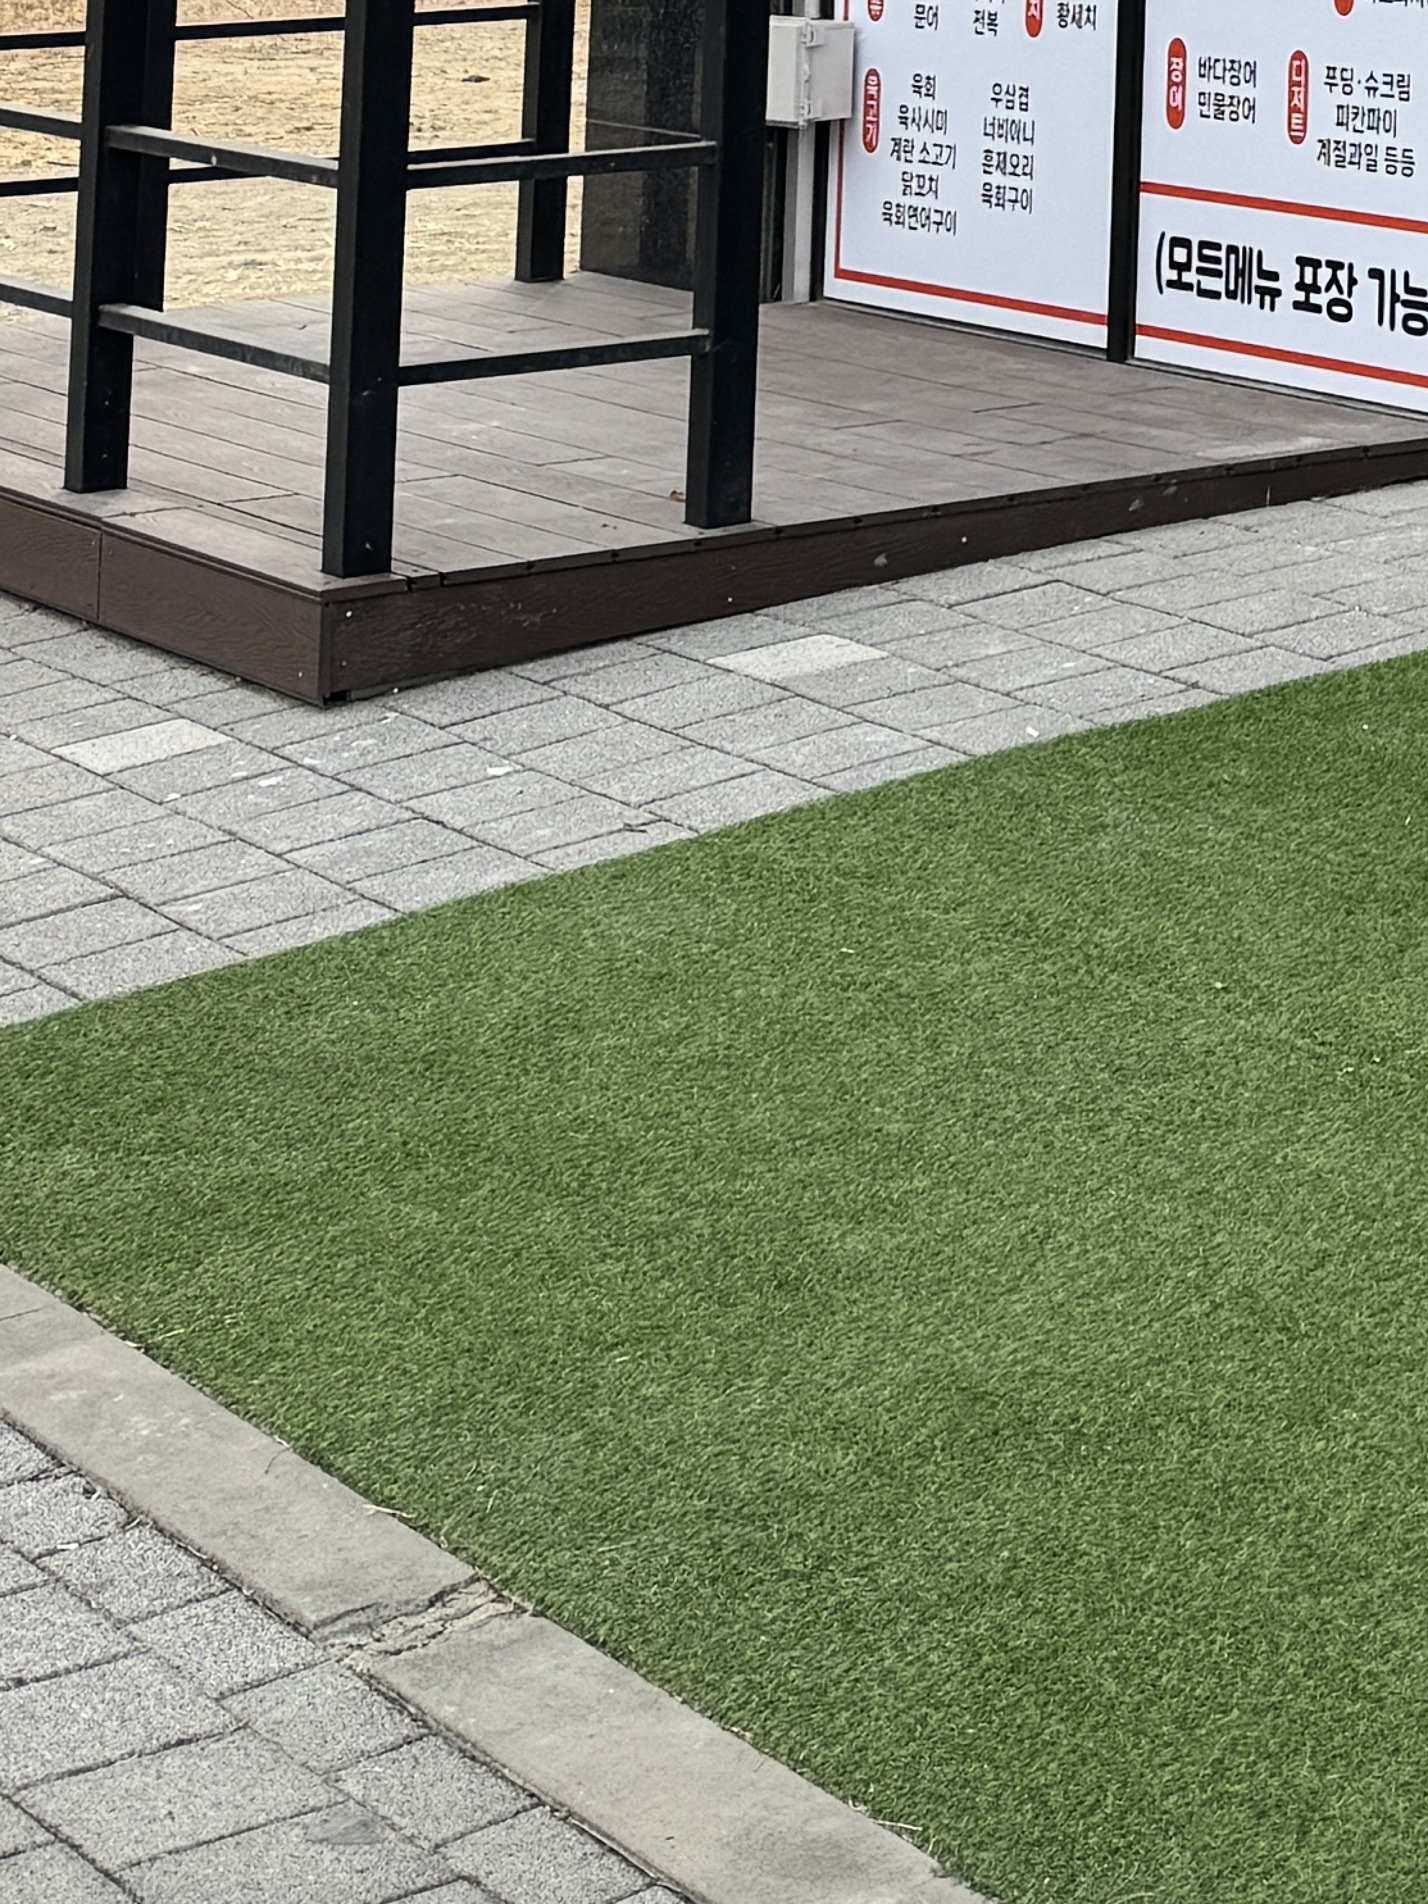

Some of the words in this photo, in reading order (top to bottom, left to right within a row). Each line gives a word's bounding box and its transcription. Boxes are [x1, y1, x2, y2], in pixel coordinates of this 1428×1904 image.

[914, 4, 938, 30] 문어
[973, 10, 998, 36] 전복
[912, 73, 936, 100] 육회
[1199, 56, 1256, 88] 바다장어
[991, 83, 1029, 112] 우삼겹
[1198, 92, 1255, 124] 민물장어
[1289, 58, 1305, 137] 디저트
[1336, 104, 1396, 138] 피칸파이
[918, 142, 956, 169] 소고기
[1317, 139, 1378, 172] 계절과일
[1384, 146, 1415, 177] 등등
[1156, 231, 1282, 312] (모든메뉴
[1292, 256, 1358, 323] 포장
